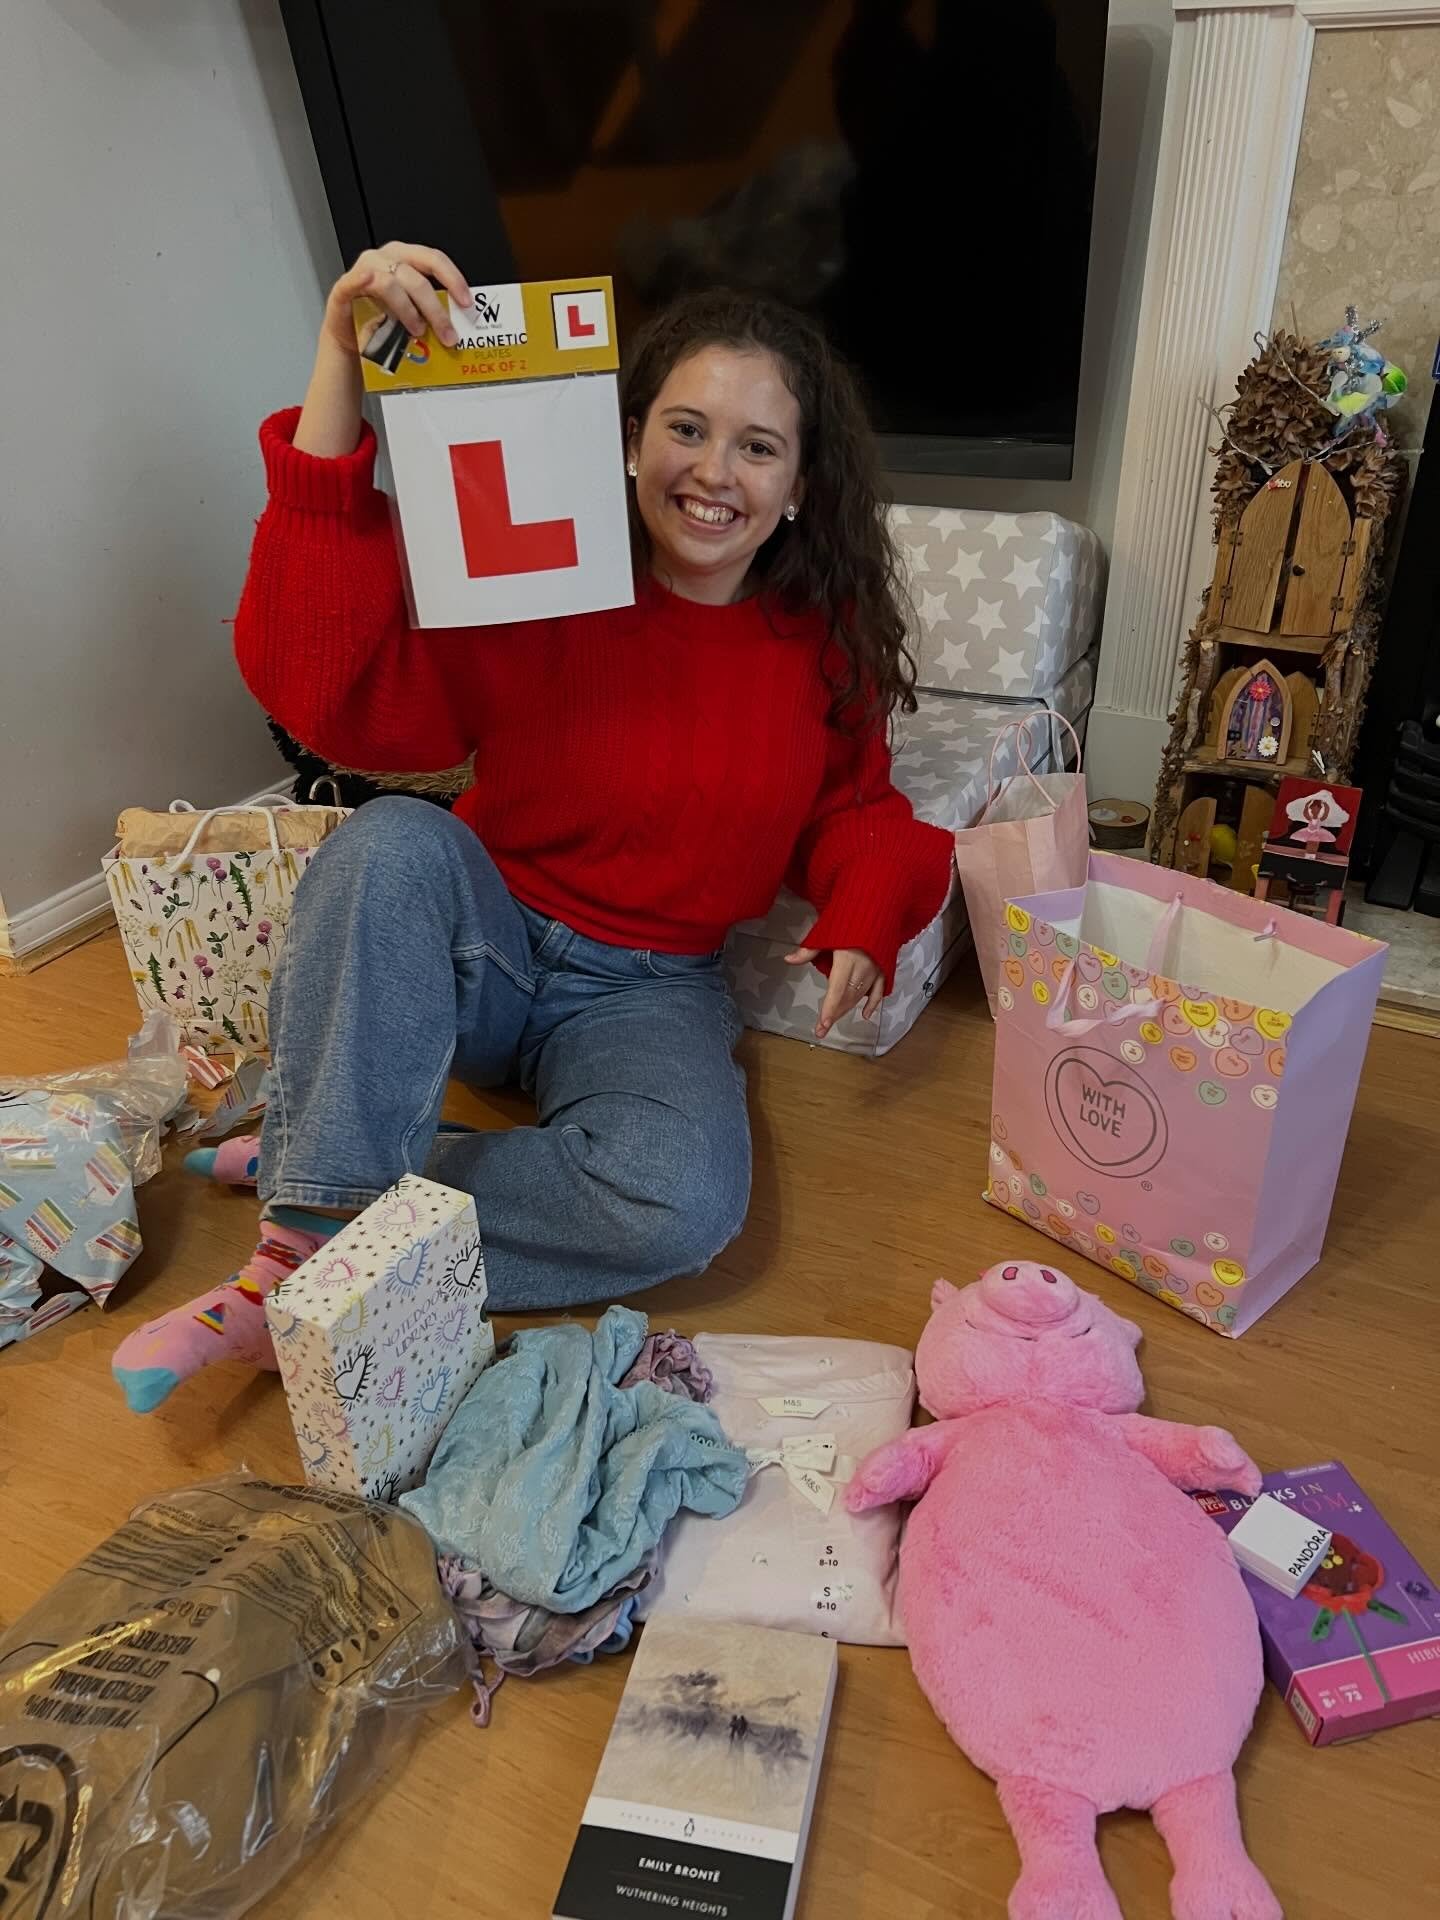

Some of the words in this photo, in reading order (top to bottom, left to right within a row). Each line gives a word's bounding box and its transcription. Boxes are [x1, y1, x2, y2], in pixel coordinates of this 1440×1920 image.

[567, 305, 595, 337] L
[456, 333, 528, 349] MAGNETIC
[474, 348, 512, 360] PLATES
[462, 363, 496, 376] PACK
[499, 360, 515, 372] OF
[519, 359, 528, 370] 2
[449, 439, 579, 579] L
[1082, 1083, 1126, 1119] WITH
[1080, 1103, 1122, 1138] LOVE
[783, 1399, 802, 1408] M&S
[801, 1472, 822, 1494] M&S
[1230, 1487, 1296, 1511] BLKS
[1301, 1482, 1324, 1497] IN
[825, 1545, 833, 1555] S
[1288, 1529, 1330, 1577] PANDORA
[819, 1559, 839, 1567] 8-10
[823, 1586, 831, 1597] S
[816, 1601, 837, 1611] 8-10
[638, 1857, 673, 1873] EMILY
[616, 1884, 680, 1907] WUTHERING
[681, 1899, 729, 1918] HEIGHTS
